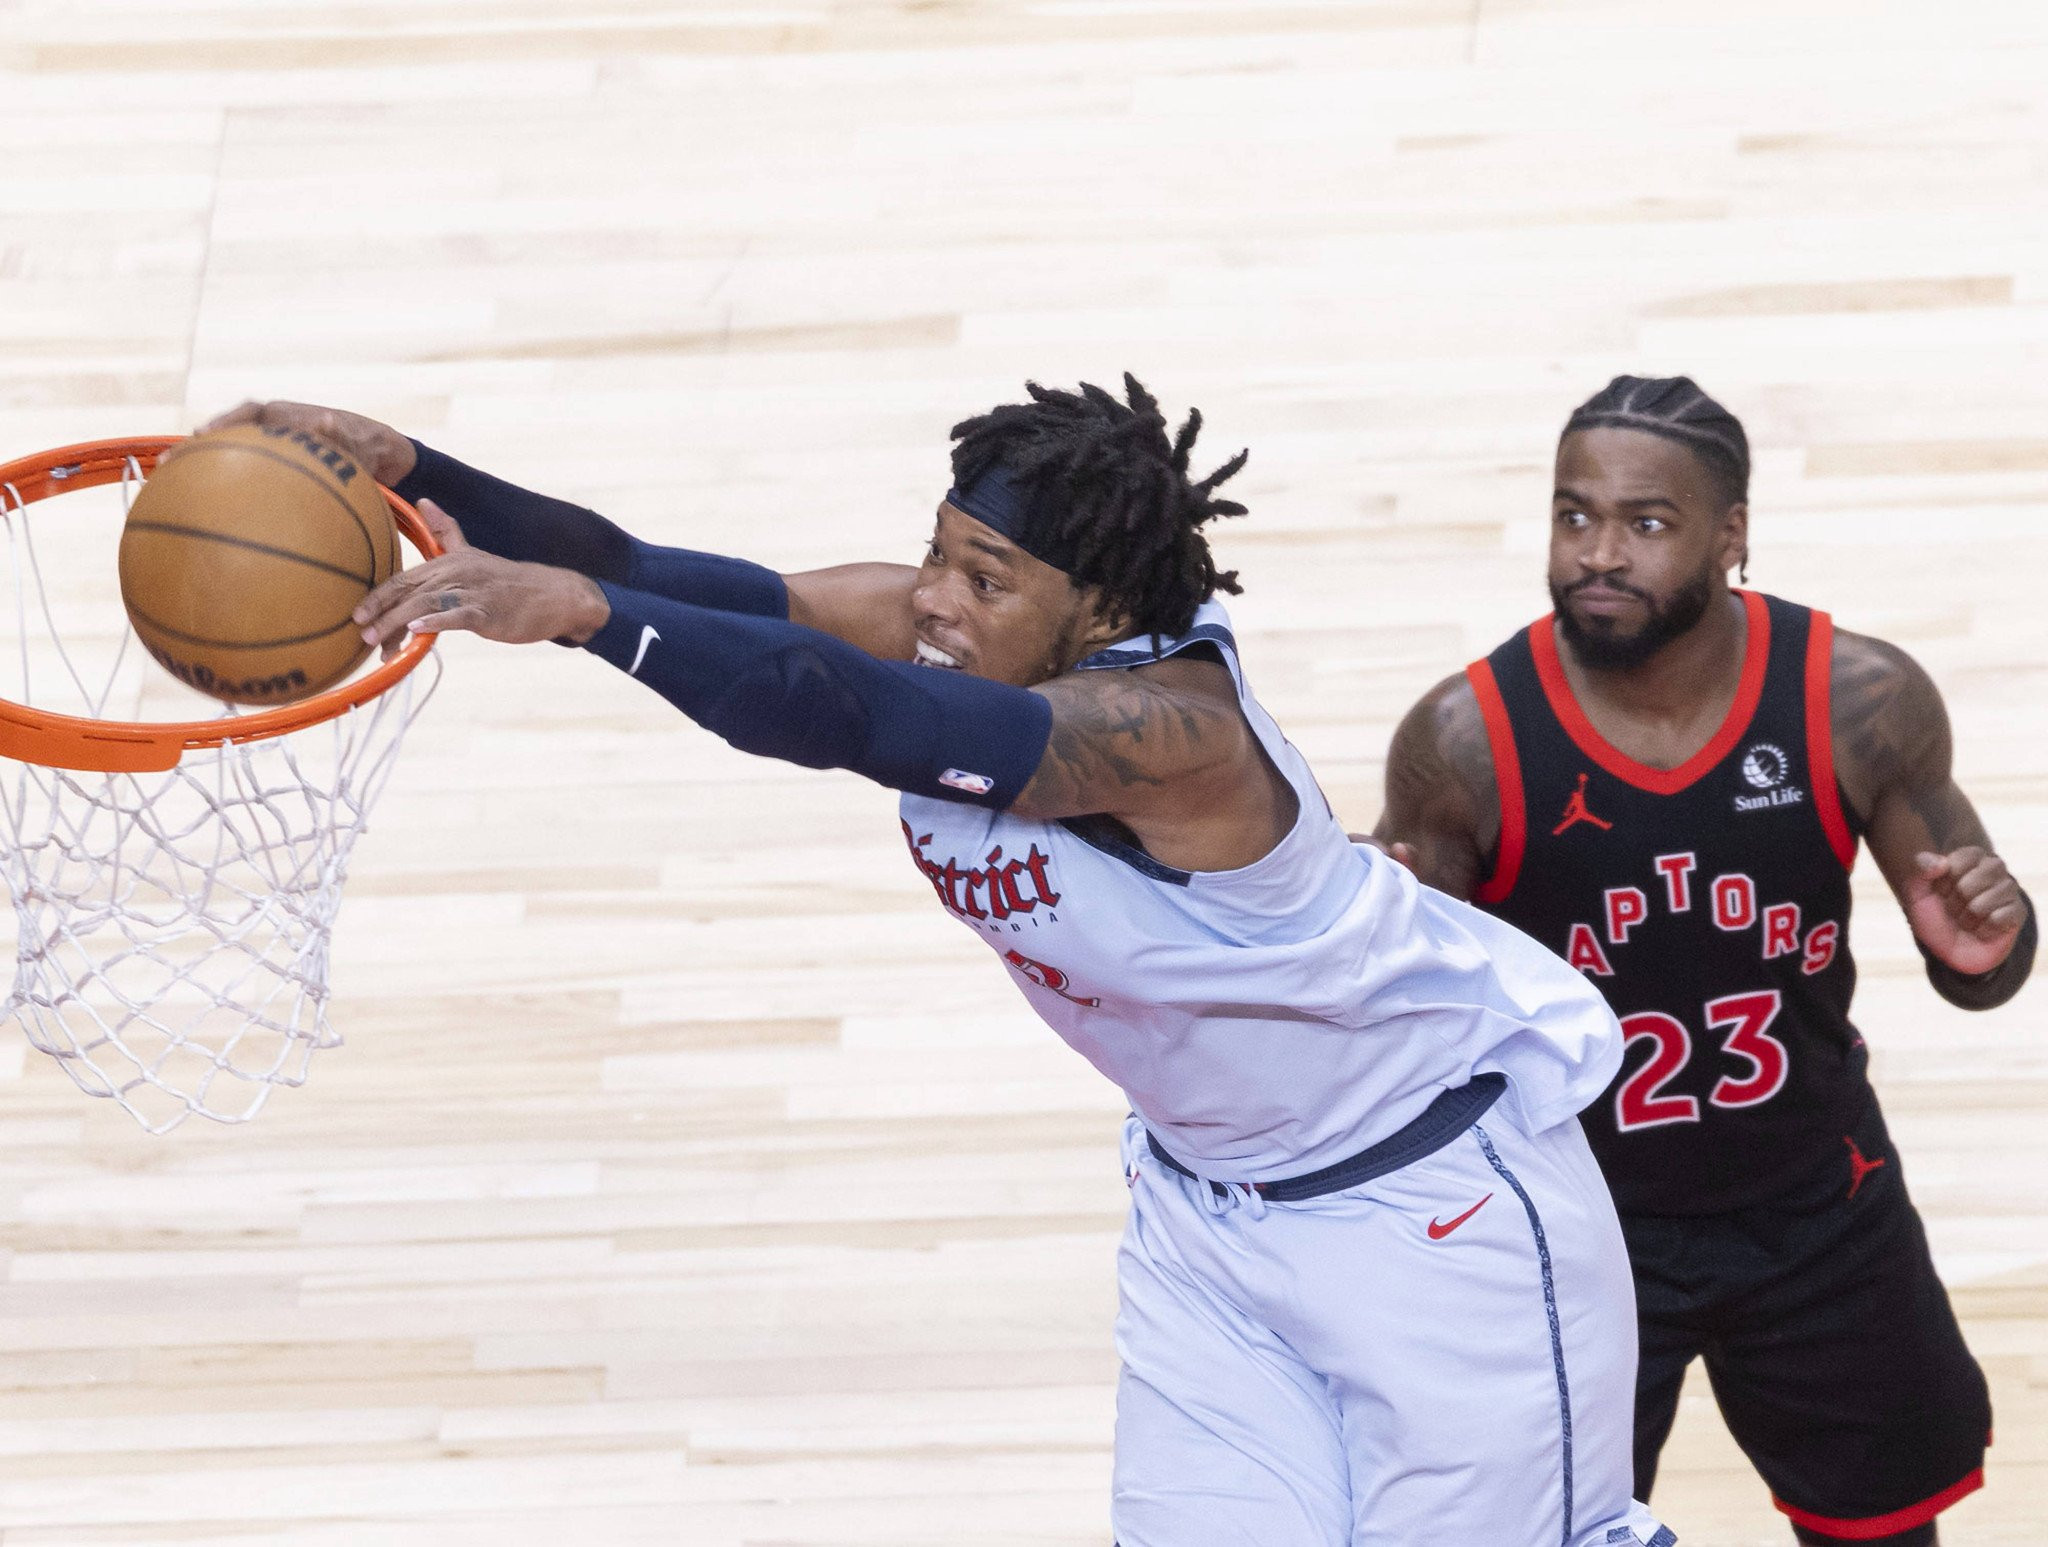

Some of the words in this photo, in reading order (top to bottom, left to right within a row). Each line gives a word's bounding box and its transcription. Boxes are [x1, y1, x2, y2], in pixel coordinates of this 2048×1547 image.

[1735, 795, 1769, 811] Sun
[1770, 786, 1803, 805] Life
[900, 815, 1061, 921] istrict
[1568, 852, 1838, 975] APTORS
[972, 911, 1059, 933] MBIA
[1615, 990, 1789, 1132] 23
